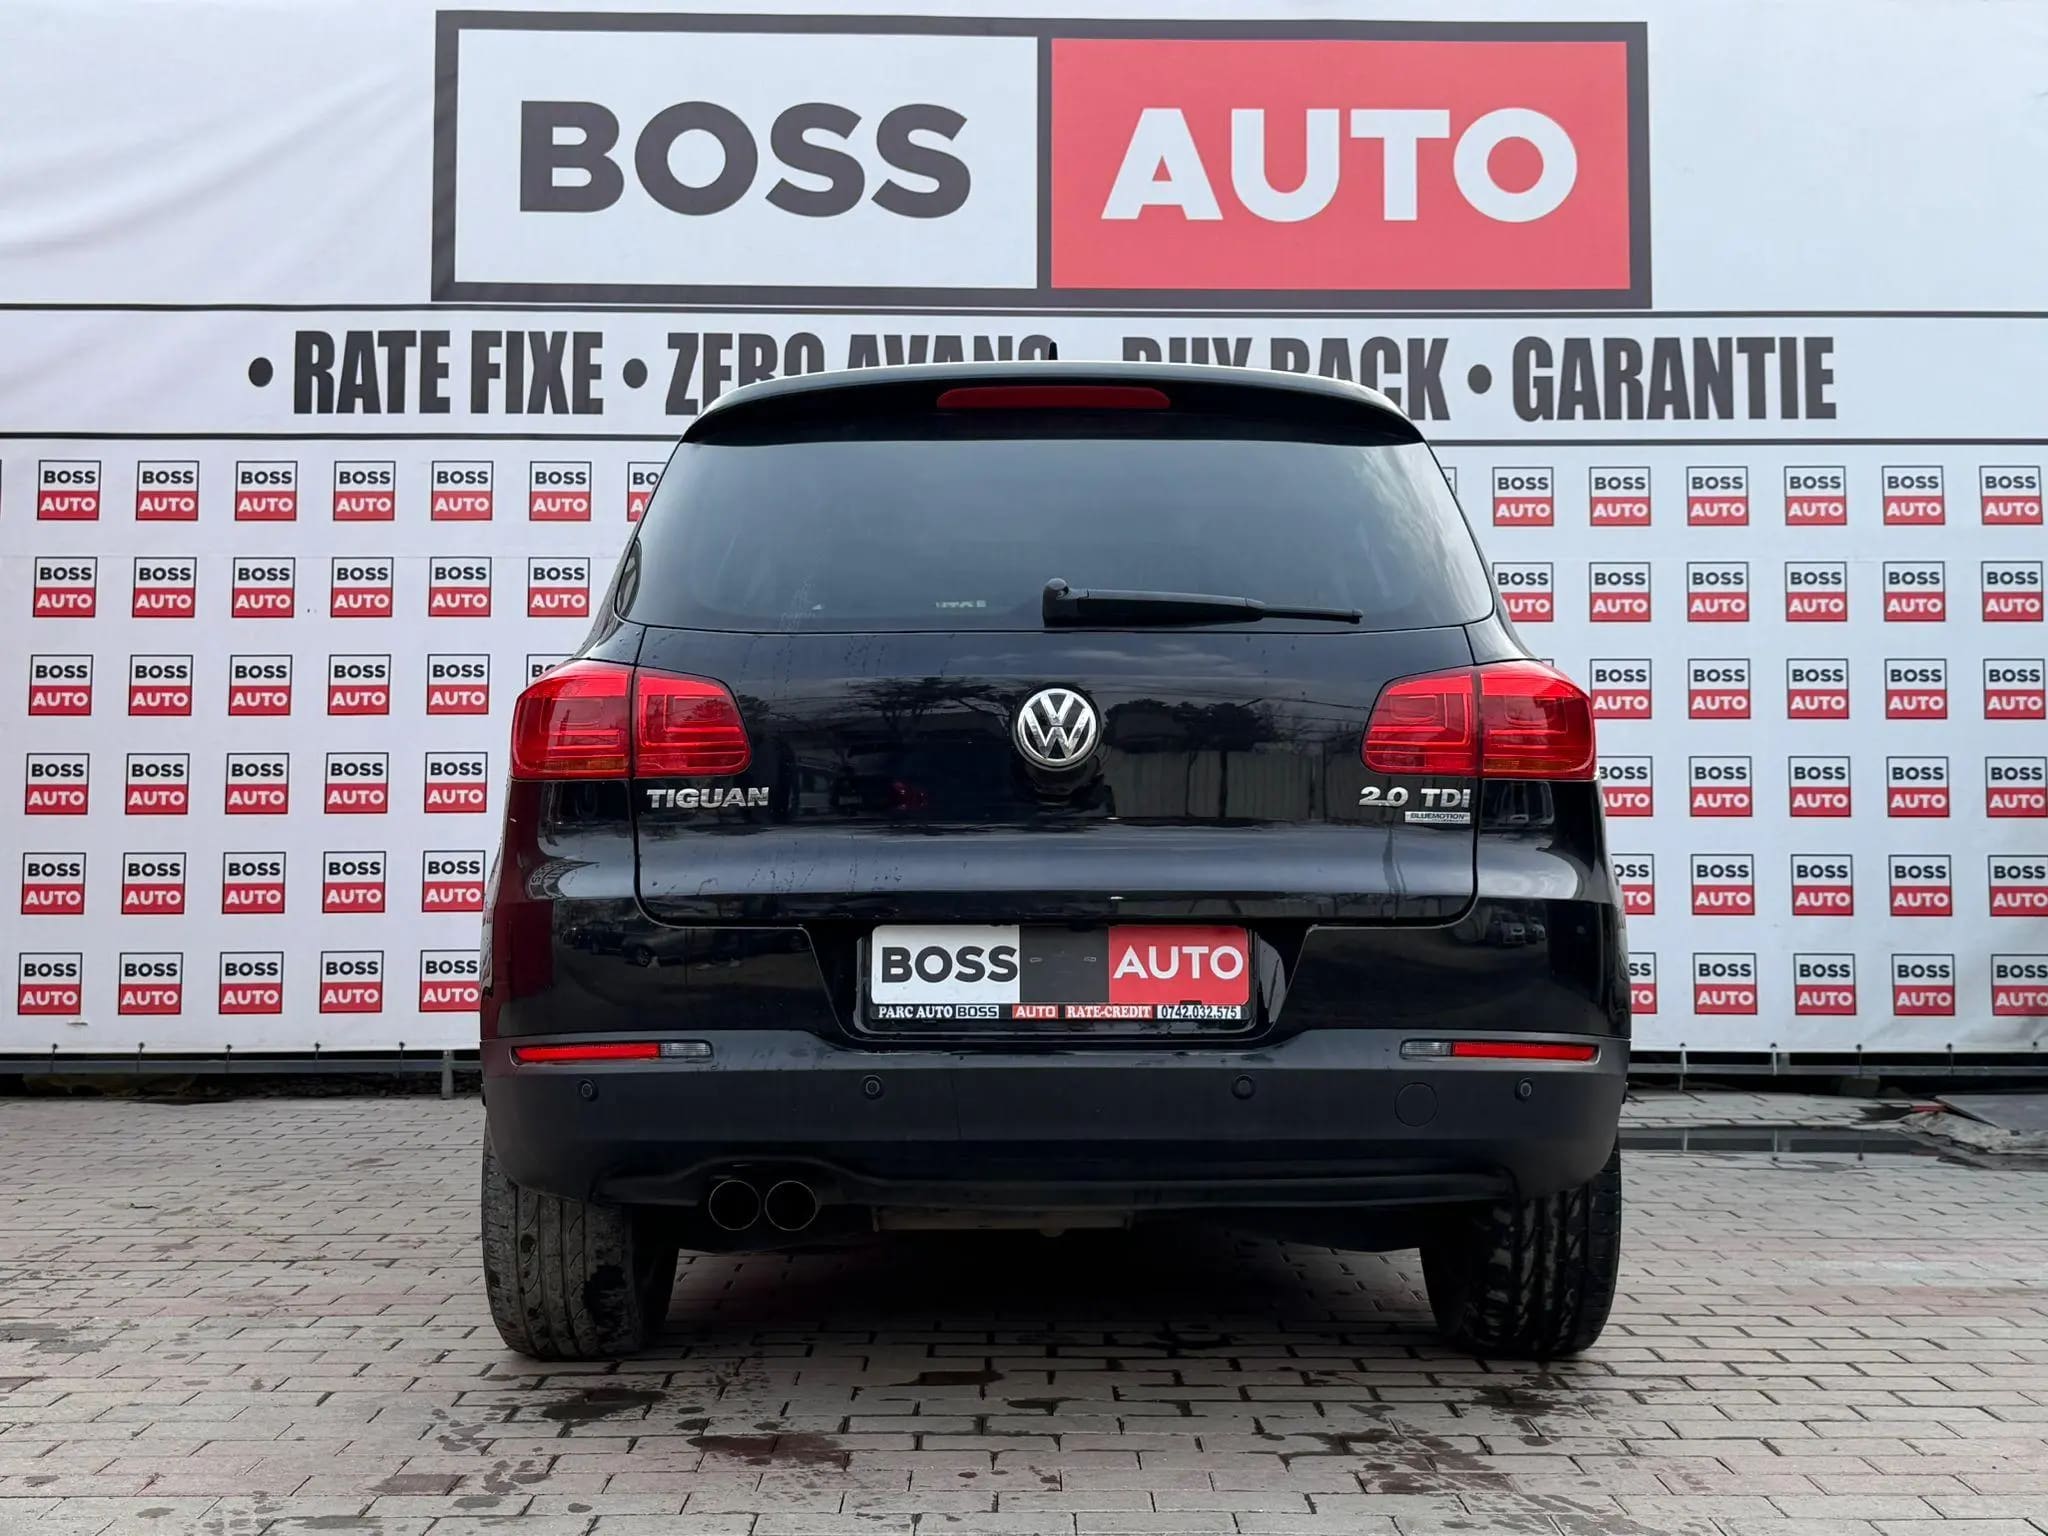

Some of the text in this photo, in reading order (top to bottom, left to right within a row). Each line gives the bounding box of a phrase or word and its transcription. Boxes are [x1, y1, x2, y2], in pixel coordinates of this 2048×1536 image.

[519, 99, 1578, 223] BOSS AUTO
[293, 330, 450, 414] RATE
[471, 330, 604, 415] FIXE
[1512, 336, 1837, 422] GARANTIE
[44, 471, 95, 484] BOSS
[143, 471, 193, 484] BOSS
[241, 471, 292, 484] BOSS
[340, 471, 390, 484] BOSS
[437, 471, 488, 484] BOSS
[536, 472, 586, 484] BOSS
[633, 472, 659, 485] BO
[1498, 477, 1548, 490] BOSS
[1594, 477, 1645, 489] BOSS
[1692, 477, 1742, 489] BOSS
[1790, 476, 1840, 488] BOSS
[1888, 476, 1938, 488] BOSS
[1986, 476, 2036, 488] BOSS
[41, 498, 96, 510] AUTO
[140, 498, 194, 511] AUTO
[239, 498, 293, 511] AUTO
[337, 498, 391, 511] AUTO
[435, 498, 489, 511] AUTO
[533, 499, 587, 511] AUTO
[1498, 504, 1550, 517] AUTO
[1594, 503, 1648, 517] AUTO
[1692, 503, 1745, 517] AUTO
[1790, 503, 1843, 516] AUTO
[1888, 503, 1942, 516] AUTO
[1986, 503, 2039, 516] AUTO
[40, 567, 92, 580] BOSS
[139, 568, 191, 581] BOSS
[238, 568, 289, 581] BOSS
[337, 568, 388, 580] BOSS
[435, 567, 486, 580] BOSS
[534, 568, 584, 580] BOSS
[1498, 573, 1548, 585] BOSS
[1594, 573, 1645, 585] BOSS
[1692, 572, 1743, 585] BOSS
[1790, 572, 1841, 584] BOSS
[1888, 572, 1939, 584] BOSS
[1987, 572, 2038, 584] BOSS
[37, 595, 92, 607] AUTO
[136, 595, 191, 608] AUTO
[236, 595, 290, 608] AUTO
[335, 595, 389, 608] AUTO
[432, 594, 487, 607] AUTO
[531, 594, 586, 608] AUTO
[1594, 599, 1647, 613] AUTO
[1692, 599, 1746, 612] AUTO
[1790, 599, 1844, 612] AUTO
[1888, 599, 1942, 612] AUTO
[1987, 599, 2040, 612] AUTO
[36, 665, 87, 678] BOSS
[135, 665, 187, 678] BOSS
[235, 665, 287, 678] BOSS
[334, 665, 385, 678] BOSS
[433, 664, 484, 677] BOSS
[1595, 669, 1647, 682] BOSS
[1693, 669, 1744, 682] BOSS
[1792, 669, 1843, 682] BOSS
[1891, 669, 1941, 682] BOSS
[1989, 669, 2040, 682] BOSS
[33, 693, 88, 706] AUTO
[132, 693, 188, 706] AUTO
[232, 693, 287, 706] AUTO
[331, 692, 385, 705] AUTO
[431, 692, 485, 705] AUTO
[1593, 696, 1649, 710] AUTO
[1693, 696, 1747, 709] AUTO
[1792, 696, 1845, 709] AUTO
[1891, 696, 1944, 709] AUTO
[1989, 697, 2042, 710] AUTO
[32, 764, 84, 777] BOSS
[132, 764, 184, 777] BOSS
[232, 763, 283, 777] BOSS
[331, 763, 383, 776] BOSS
[431, 762, 482, 775] BOSS
[1694, 767, 1746, 779] BOSS
[1794, 767, 1845, 780] BOSS
[1892, 767, 1944, 780] BOSS
[1991, 767, 2042, 780] BOSS
[29, 792, 84, 805] AUTO
[129, 792, 184, 805] AUTO
[230, 791, 284, 804] AUTO
[328, 791, 384, 804] AUTO
[428, 790, 483, 803] AUTO
[647, 786, 769, 809] TIGUAN
[1358, 786, 1471, 808] 2.0 TDI
[1694, 794, 1749, 807] AUTO
[1794, 794, 1847, 807] AUTO
[1892, 795, 1946, 808] AUTO
[1991, 795, 2044, 808] AUTO
[28, 863, 80, 877] BOSS
[128, 863, 180, 876] BOSS
[229, 863, 280, 876] BOSS
[329, 862, 380, 875] BOSS
[428, 861, 480, 874] BOSS
[1614, 864, 1650, 877] OSS
[1696, 865, 1749, 878] BOSS
[1797, 865, 1848, 878] BOSS
[1895, 865, 1946, 879] BOSS
[1994, 866, 2046, 879] BOSS
[26, 891, 80, 904] AUTO
[126, 891, 180, 904] AUTO
[226, 890, 280, 904] AUTO
[327, 890, 381, 903] AUTO
[426, 889, 481, 902] AUTO
[1624, 891, 1651, 906] TO
[1696, 892, 1751, 905] AUTO
[1797, 893, 1850, 906] AUTO
[1895, 893, 1948, 906] AUTO
[1994, 894, 2047, 906] AUTO
[24, 963, 77, 977] BOSS
[125, 963, 177, 977] BOSS
[225, 962, 278, 976] BOSS
[326, 961, 378, 975] BOSS
[426, 960, 477, 974] BOSS
[881, 945, 1244, 984] BOSS AUTO
[1628, 963, 1652, 976] SS
[1699, 964, 1751, 977] BOSS
[1799, 964, 1850, 977] BOSS
[1898, 965, 1950, 978] BOSS
[1997, 965, 2048, 978] BOSS
[22, 992, 77, 1005] AUTO
[122, 992, 177, 1004] AUTO
[223, 991, 278, 1004] AUTO
[324, 990, 378, 1003] AUTO
[423, 989, 478, 1002] AUTO
[1699, 991, 1753, 1005] AUTO
[1799, 992, 1852, 1005] AUTO
[1898, 993, 1950, 1005] AUTO
[1997, 993, 2048, 1005] AUTO
[878, 1005, 1238, 1019] PARC AUTO BOSS AUTO RATE-CREDIT 0742.032.575
